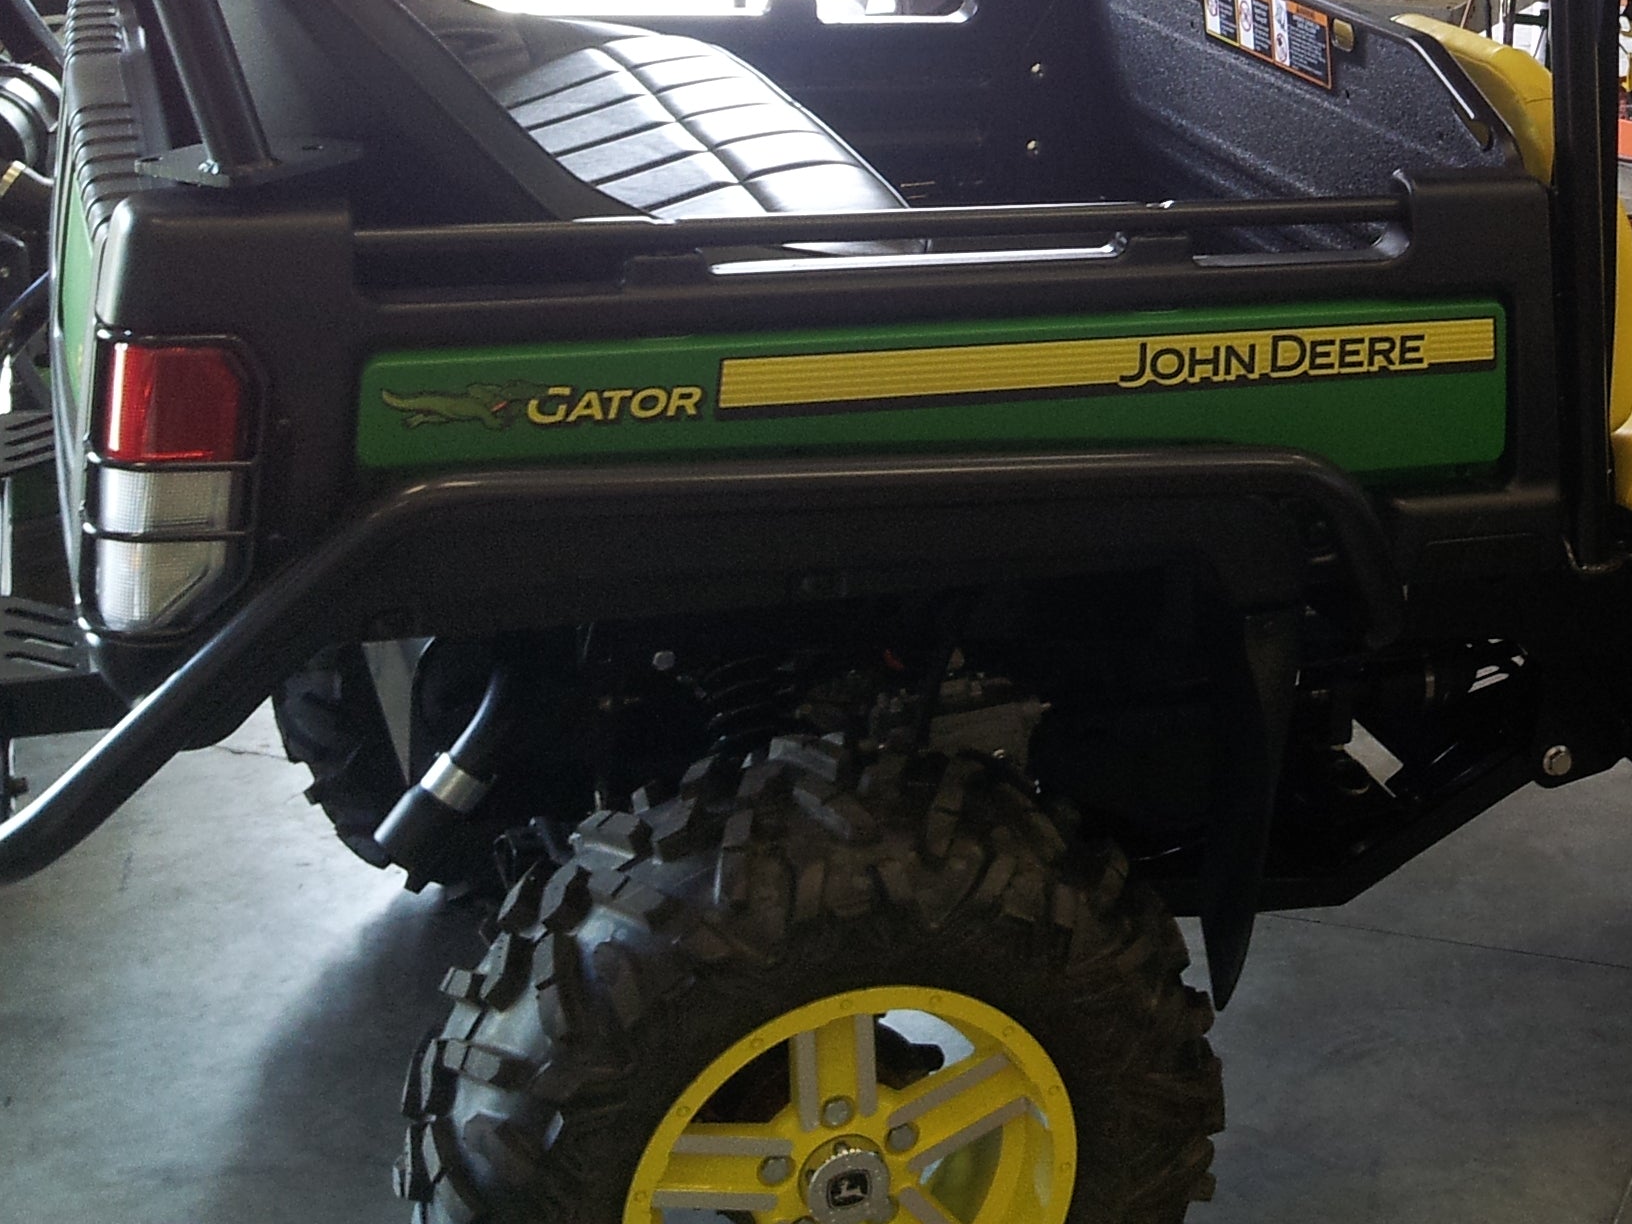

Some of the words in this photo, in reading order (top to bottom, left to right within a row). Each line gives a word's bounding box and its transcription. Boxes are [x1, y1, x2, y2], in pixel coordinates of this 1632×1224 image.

[1119, 341, 1256, 384] JOHN
[1270, 333, 1427, 374] DEERE
[527, 385, 703, 425] GATOR
